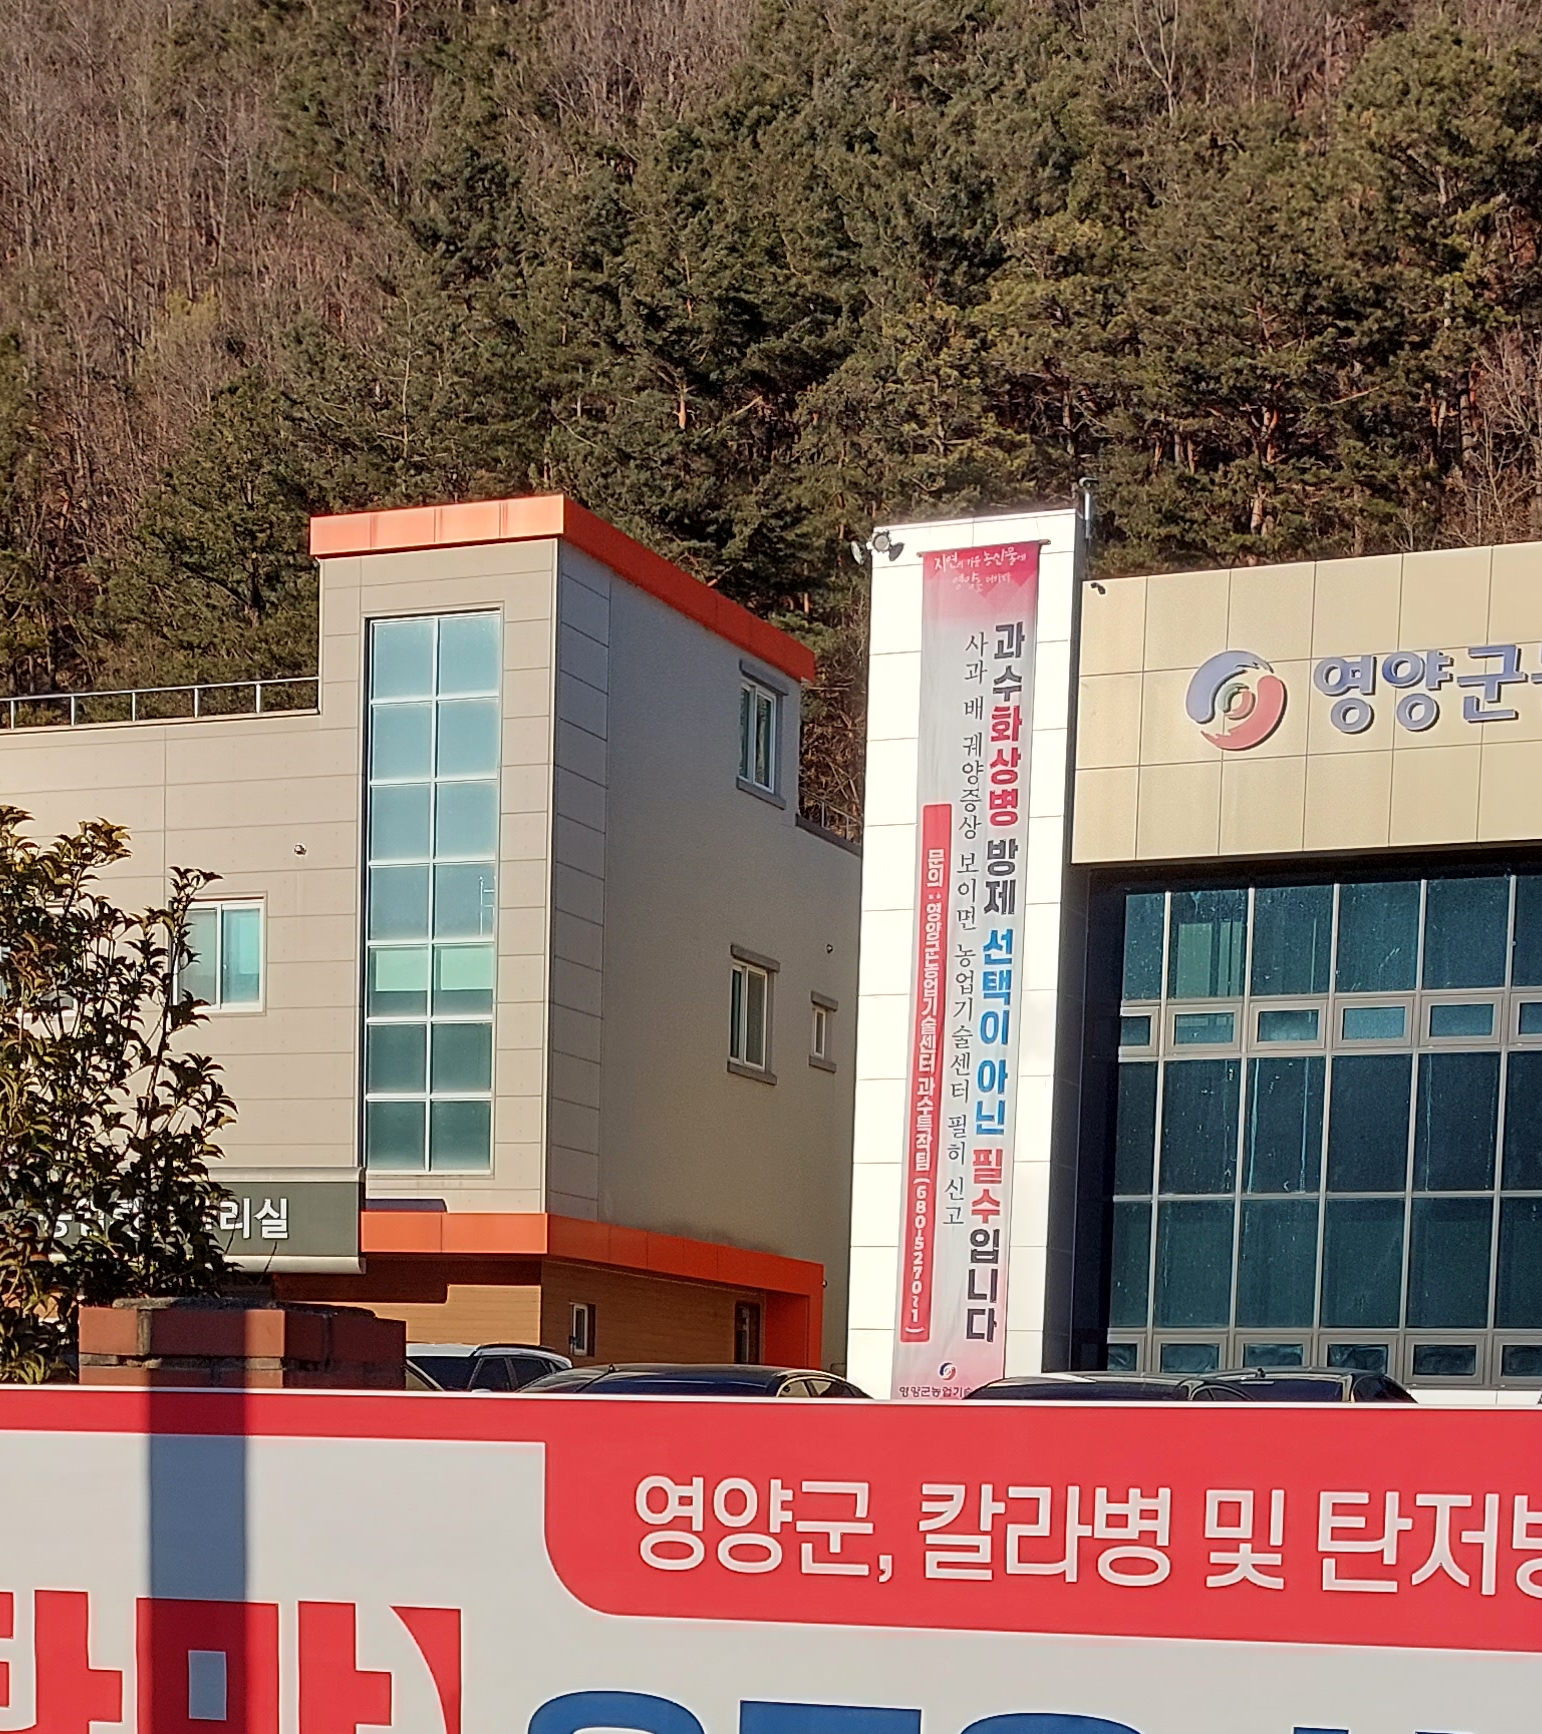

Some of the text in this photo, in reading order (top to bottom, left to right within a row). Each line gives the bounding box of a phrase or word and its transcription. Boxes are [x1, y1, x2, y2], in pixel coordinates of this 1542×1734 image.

[943, 631, 988, 1225] 사과 배 궤양증상 보이면 농업기술센터 필히 신고
[966, 621, 1025, 1343] 과수화상병 방제 선택이 아닌 필수입니다
[635, 1475, 893, 1583] 영양군,
[918, 1483, 1171, 1587] 칼라병
[1204, 1489, 1285, 1590] 및
